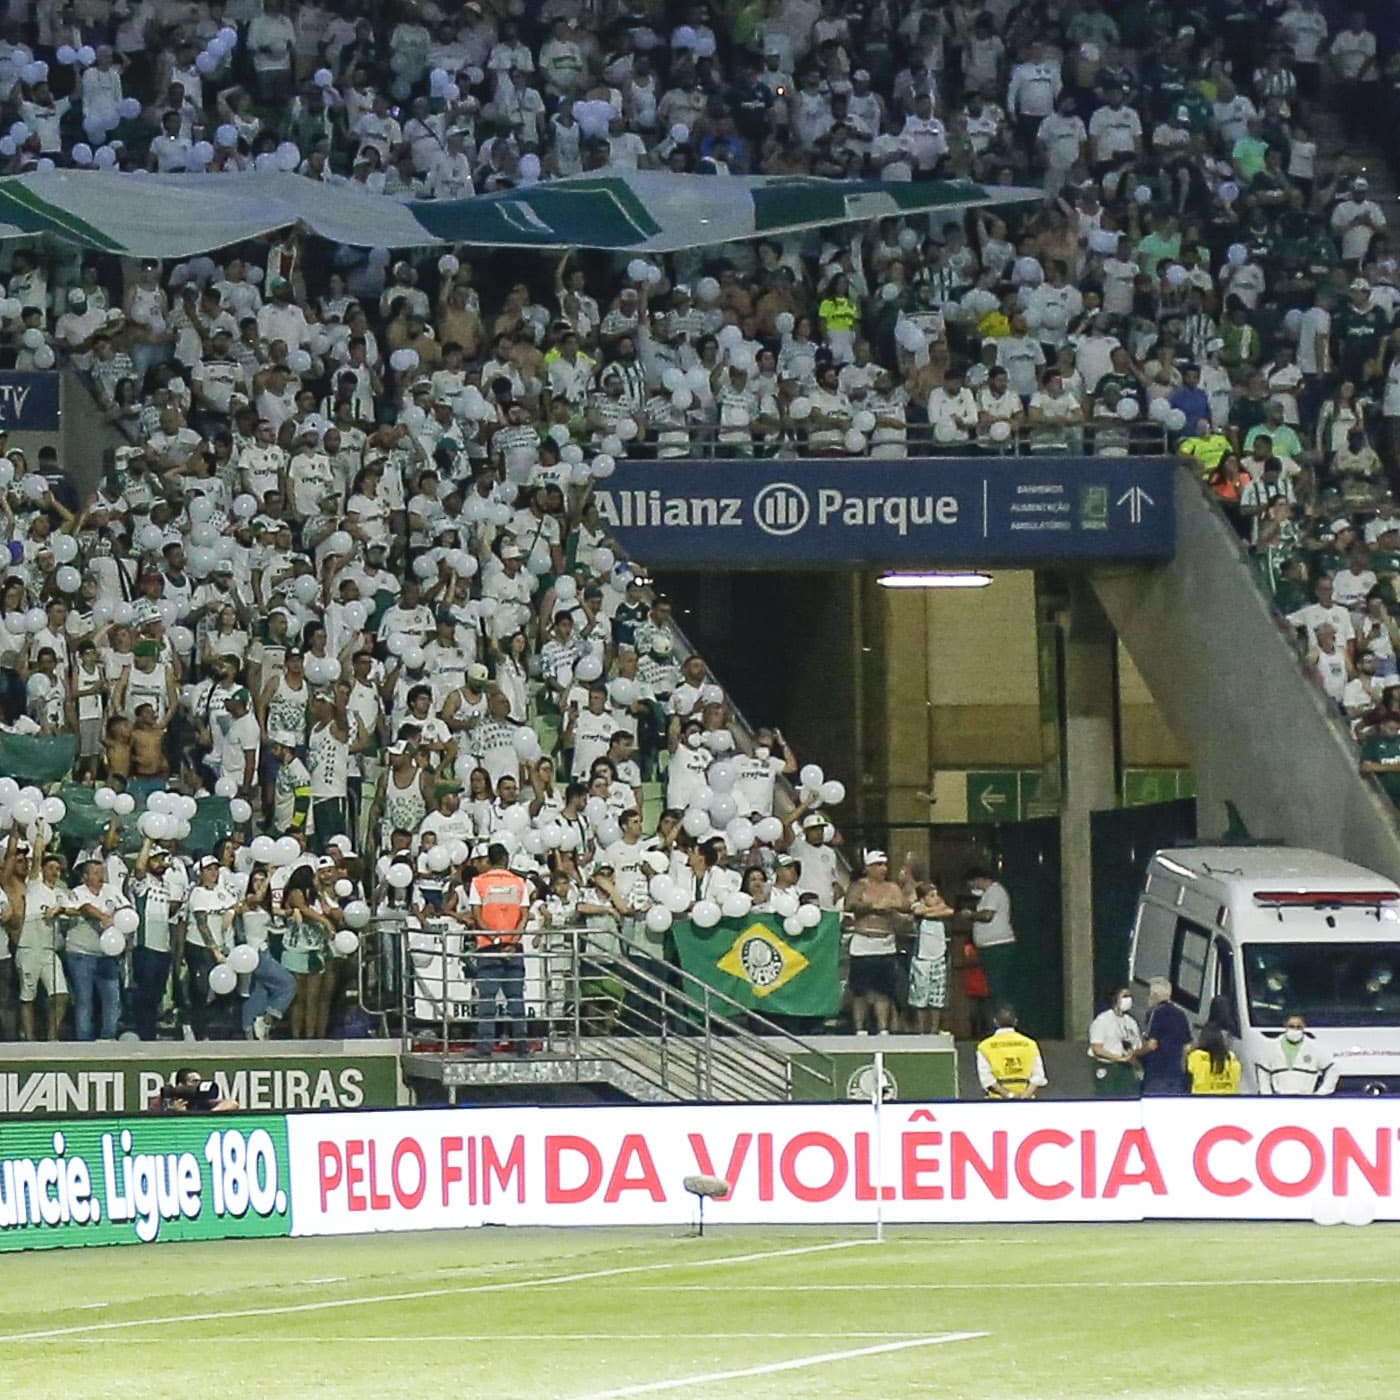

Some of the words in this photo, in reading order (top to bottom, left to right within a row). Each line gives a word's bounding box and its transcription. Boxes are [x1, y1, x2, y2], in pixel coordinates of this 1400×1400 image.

[593, 488, 743, 528] Allianz
[818, 490, 959, 535] Parque
[139, 1069, 365, 1112] PMEIRAS
[101, 1128, 202, 1243] Ligue
[204, 1128, 288, 1218] 180.
[319, 1134, 427, 1212] PELO
[440, 1133, 526, 1206] FIM
[544, 1133, 667, 1204] DA
[688, 1109, 1169, 1202] VIOLÊNCIA
[1193, 1123, 1400, 1198] CON
